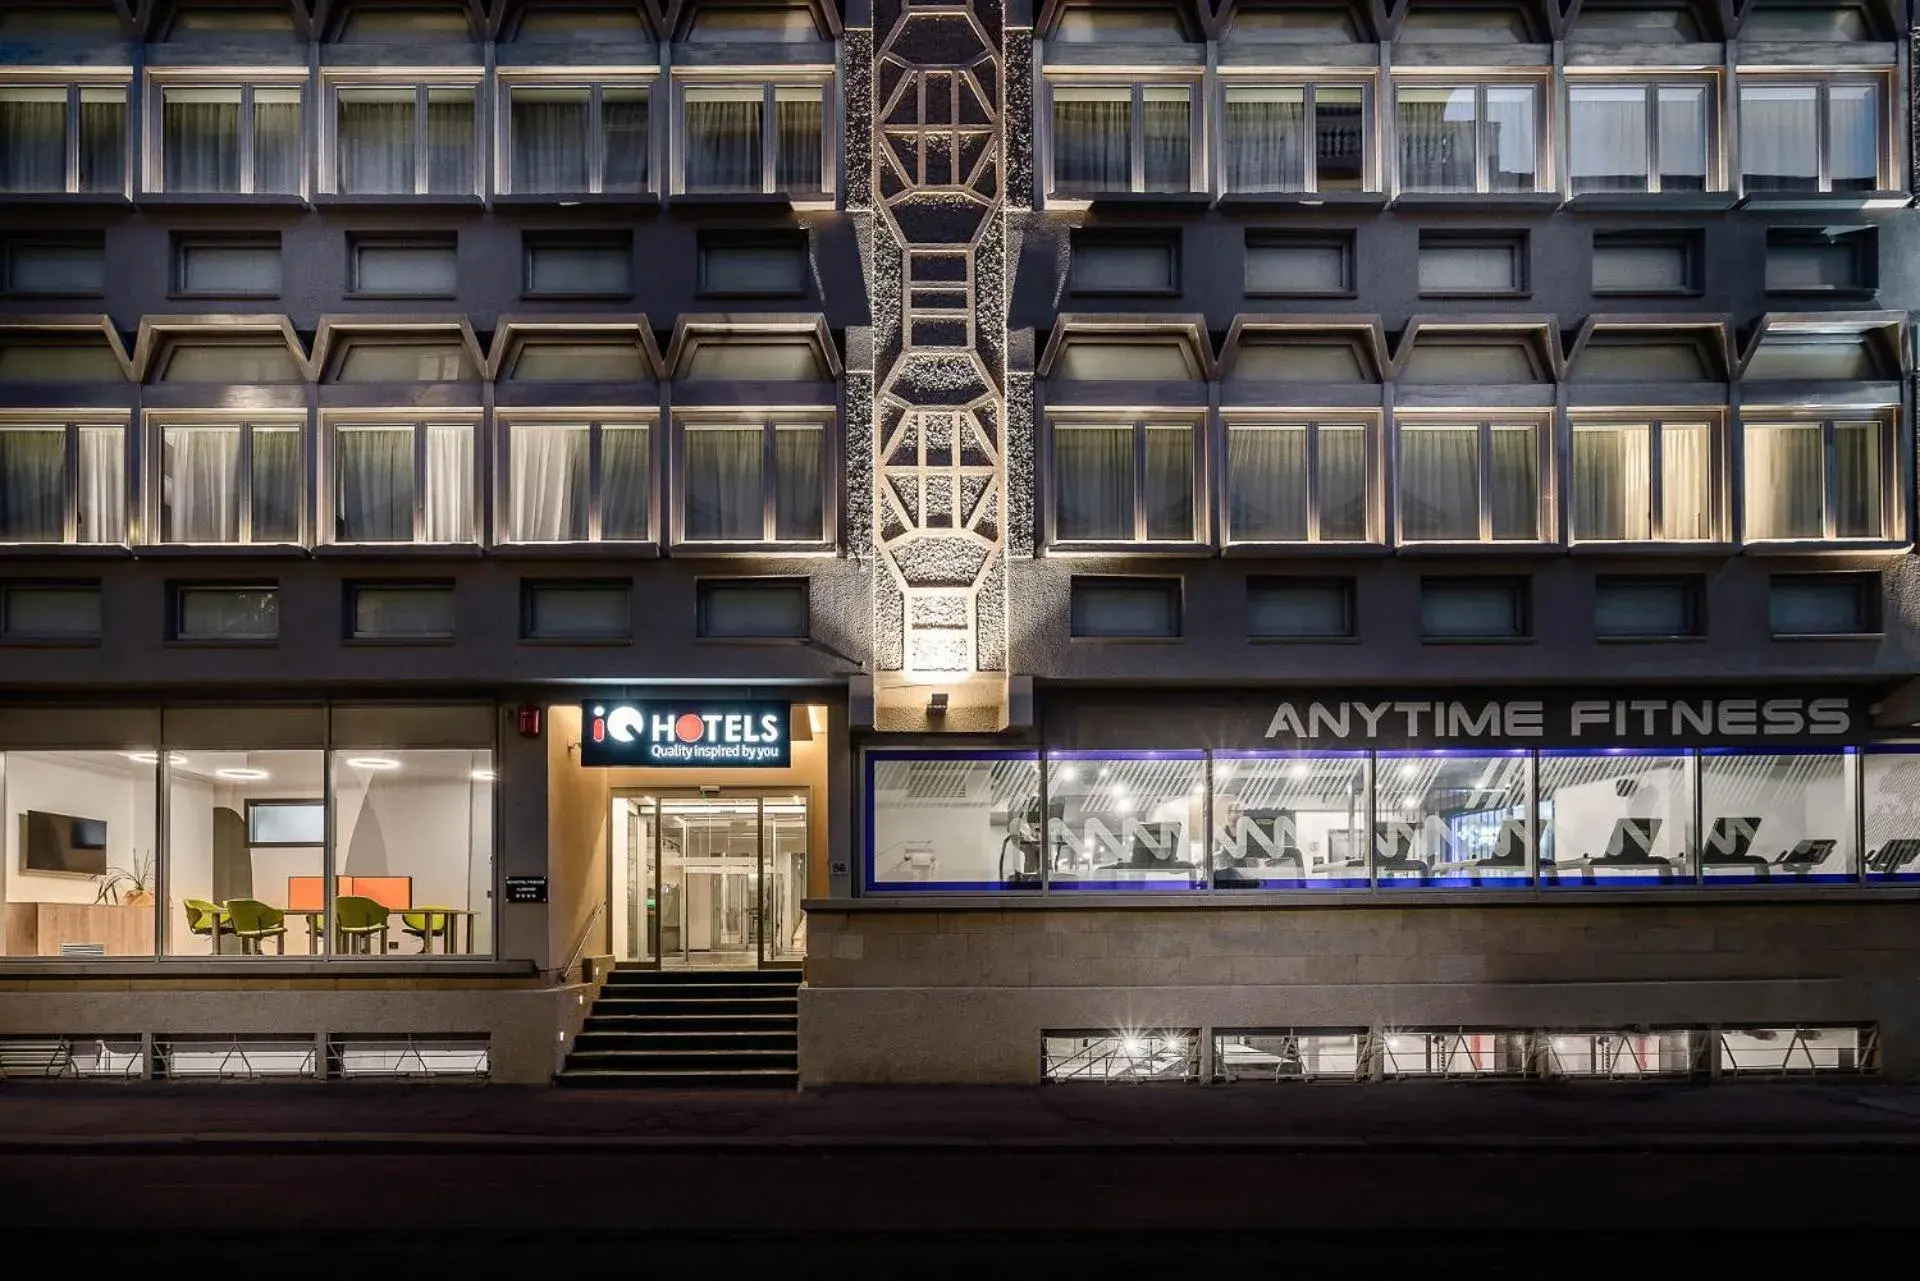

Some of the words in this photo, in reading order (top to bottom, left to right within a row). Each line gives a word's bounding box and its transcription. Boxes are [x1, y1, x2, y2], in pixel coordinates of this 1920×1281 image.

[593, 706, 644, 742] iQ
[652, 713, 779, 743] HOTELS
[1264, 701, 1544, 738] ANYTIME
[1571, 699, 1850, 736] FITNESS
[652, 745, 693, 760] Quality
[694, 745, 740, 760] inspired
[742, 745, 756, 760] by
[757, 748, 779, 760] you
